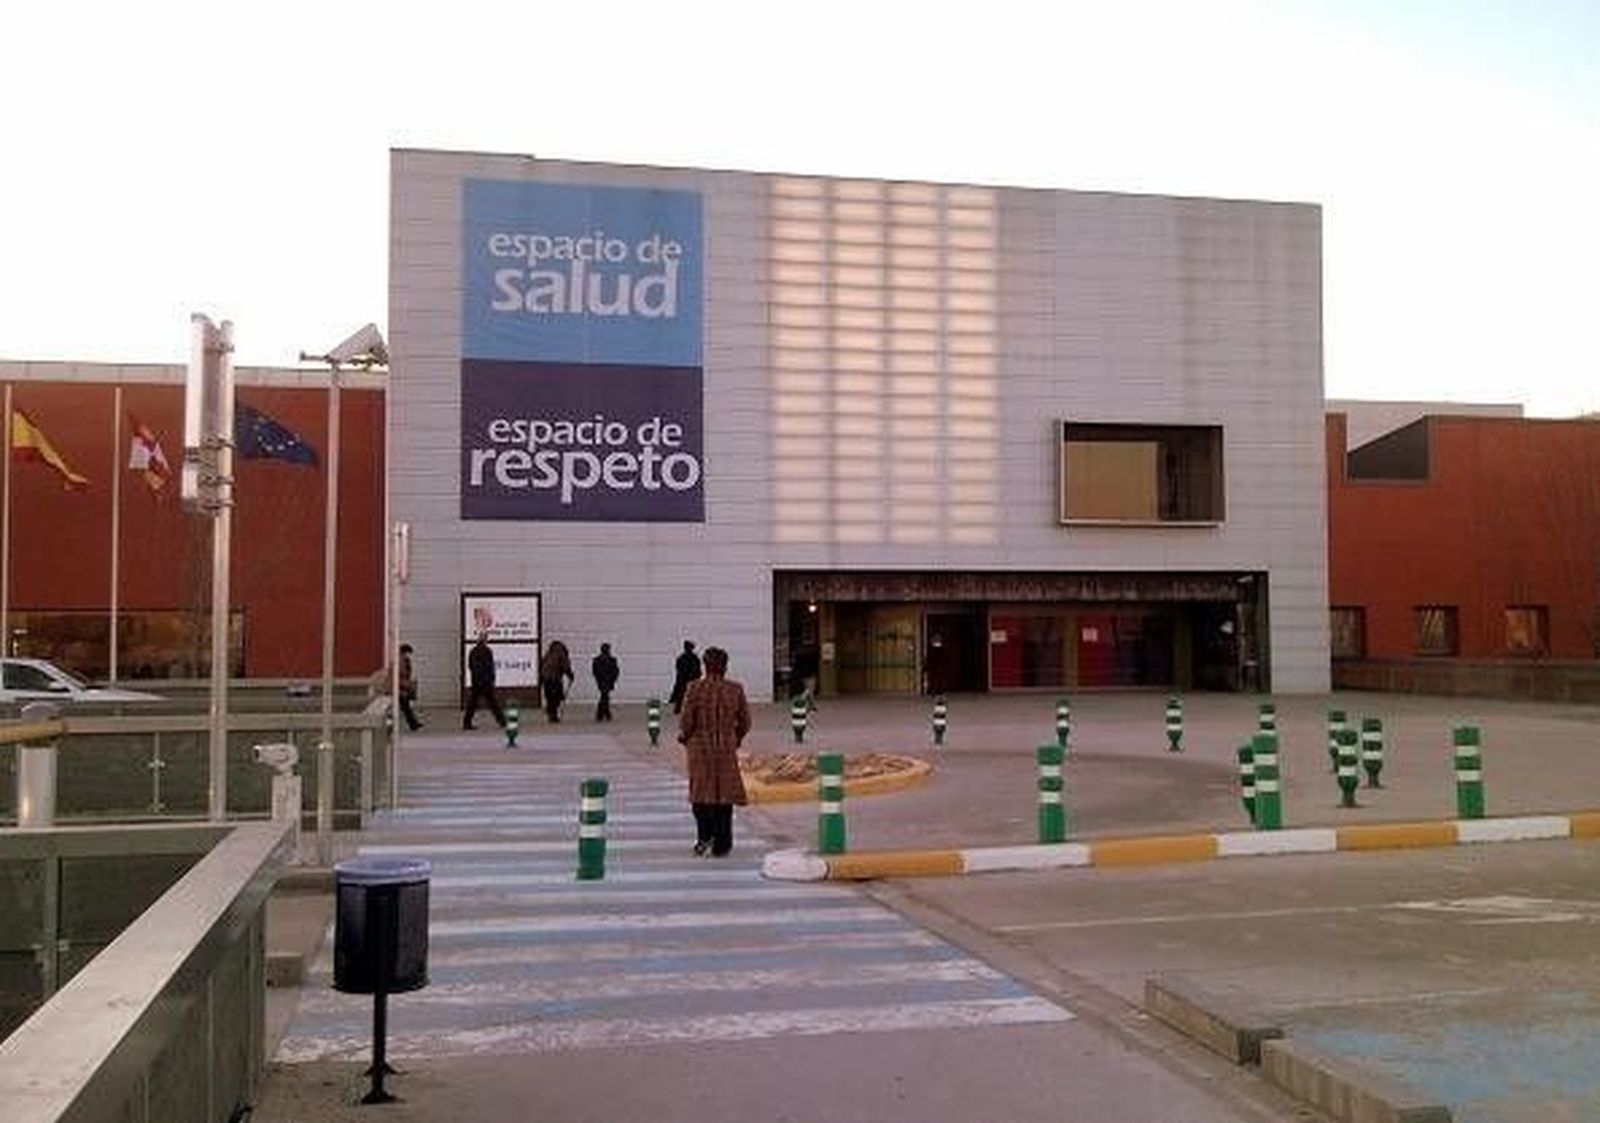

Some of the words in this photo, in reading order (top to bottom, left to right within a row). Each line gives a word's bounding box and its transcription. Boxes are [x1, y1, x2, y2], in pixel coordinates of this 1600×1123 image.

[488, 231, 627, 267] espacio
[636, 233, 683, 263] de
[491, 258, 679, 318] salud
[488, 414, 628, 453] espacio
[637, 417, 683, 447] de
[469, 446, 701, 504] respeto
